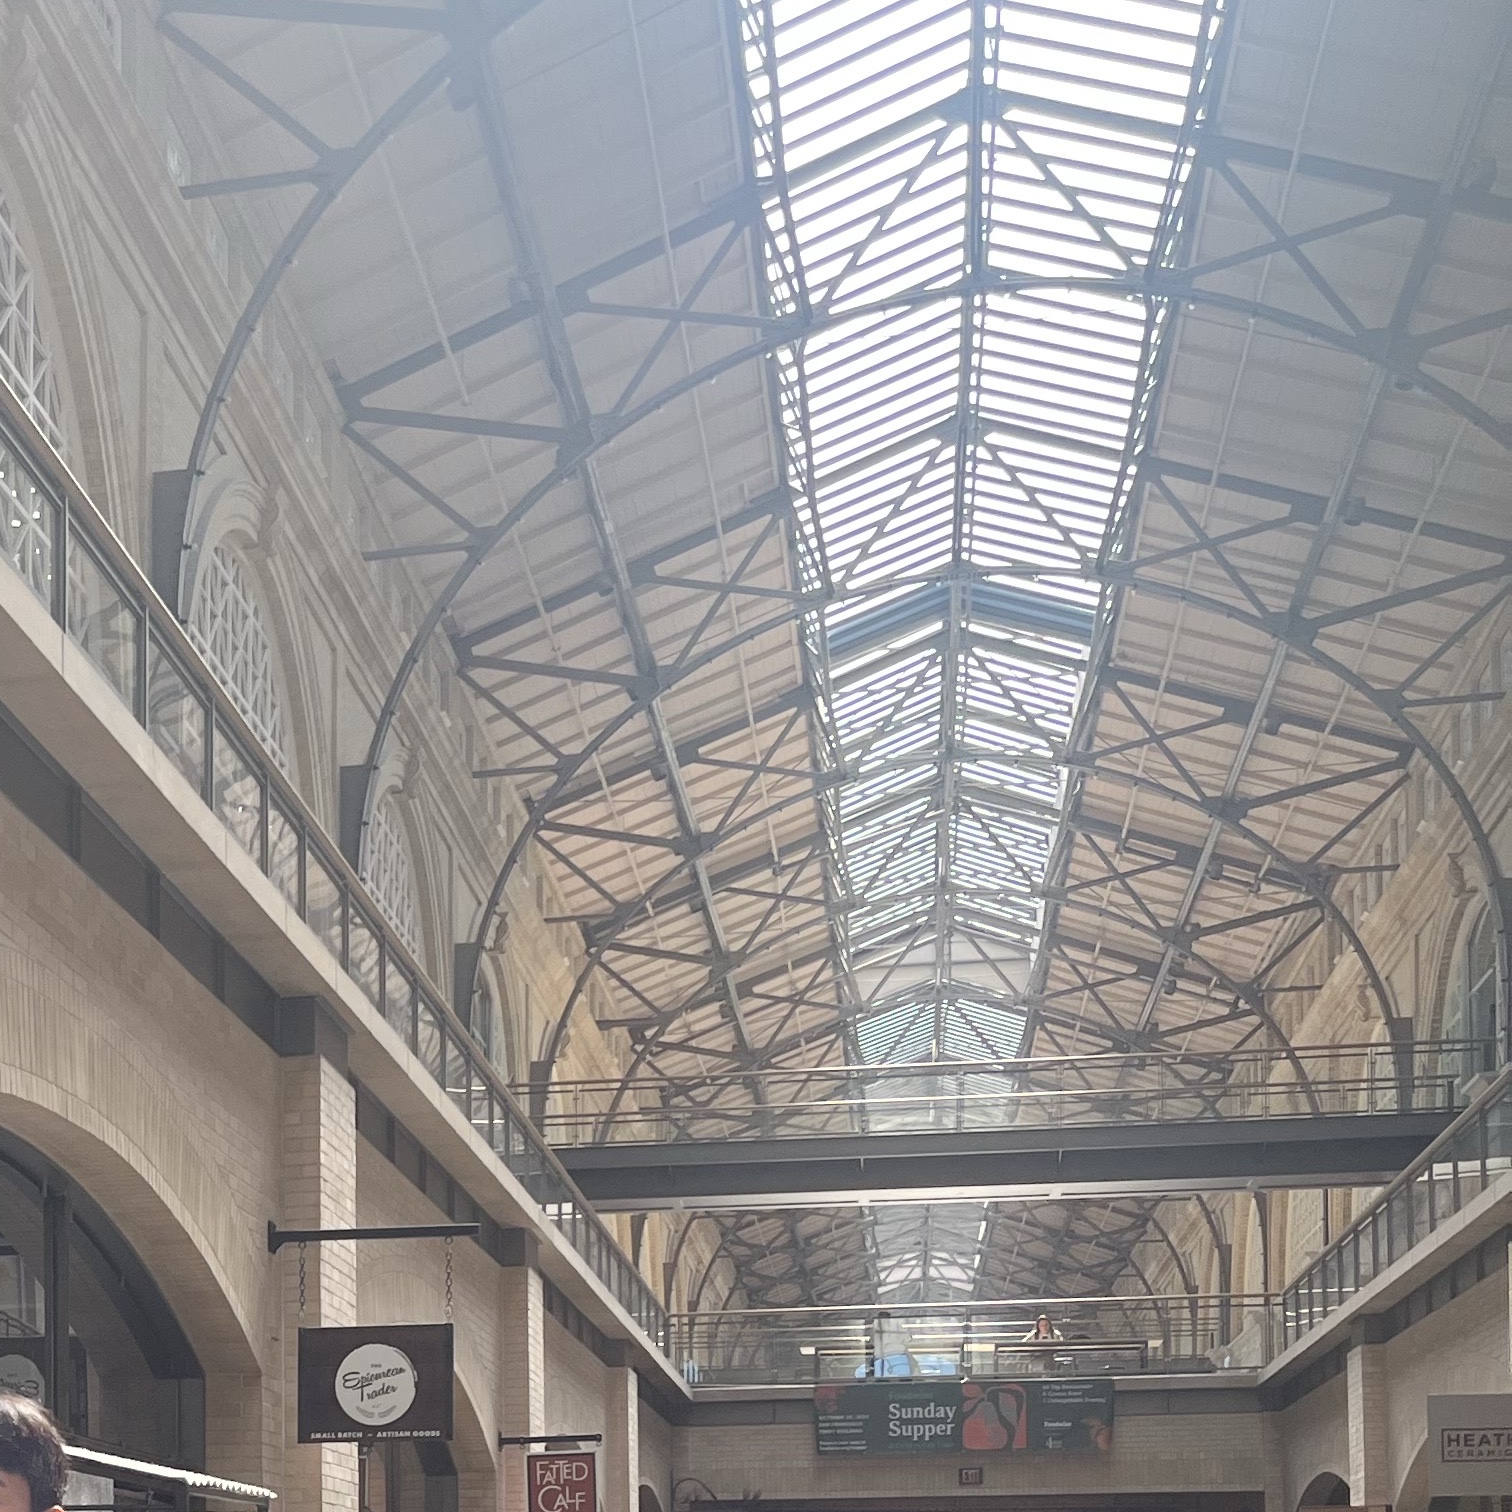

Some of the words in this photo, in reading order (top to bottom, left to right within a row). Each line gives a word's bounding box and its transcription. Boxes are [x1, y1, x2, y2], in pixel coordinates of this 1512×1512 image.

[342, 1366, 407, 1389] Epicurean
[352, 1382, 399, 1402] Trader
[888, 1402, 957, 1423] Sunday
[310, 1431, 336, 1440] SMALL
[337, 1430, 363, 1439] BATCH
[376, 1430, 411, 1439] ARTISAN
[412, 1429, 441, 1438] GOODS
[888, 1420, 956, 1441] Supper
[536, 1460, 589, 1485] FATTED
